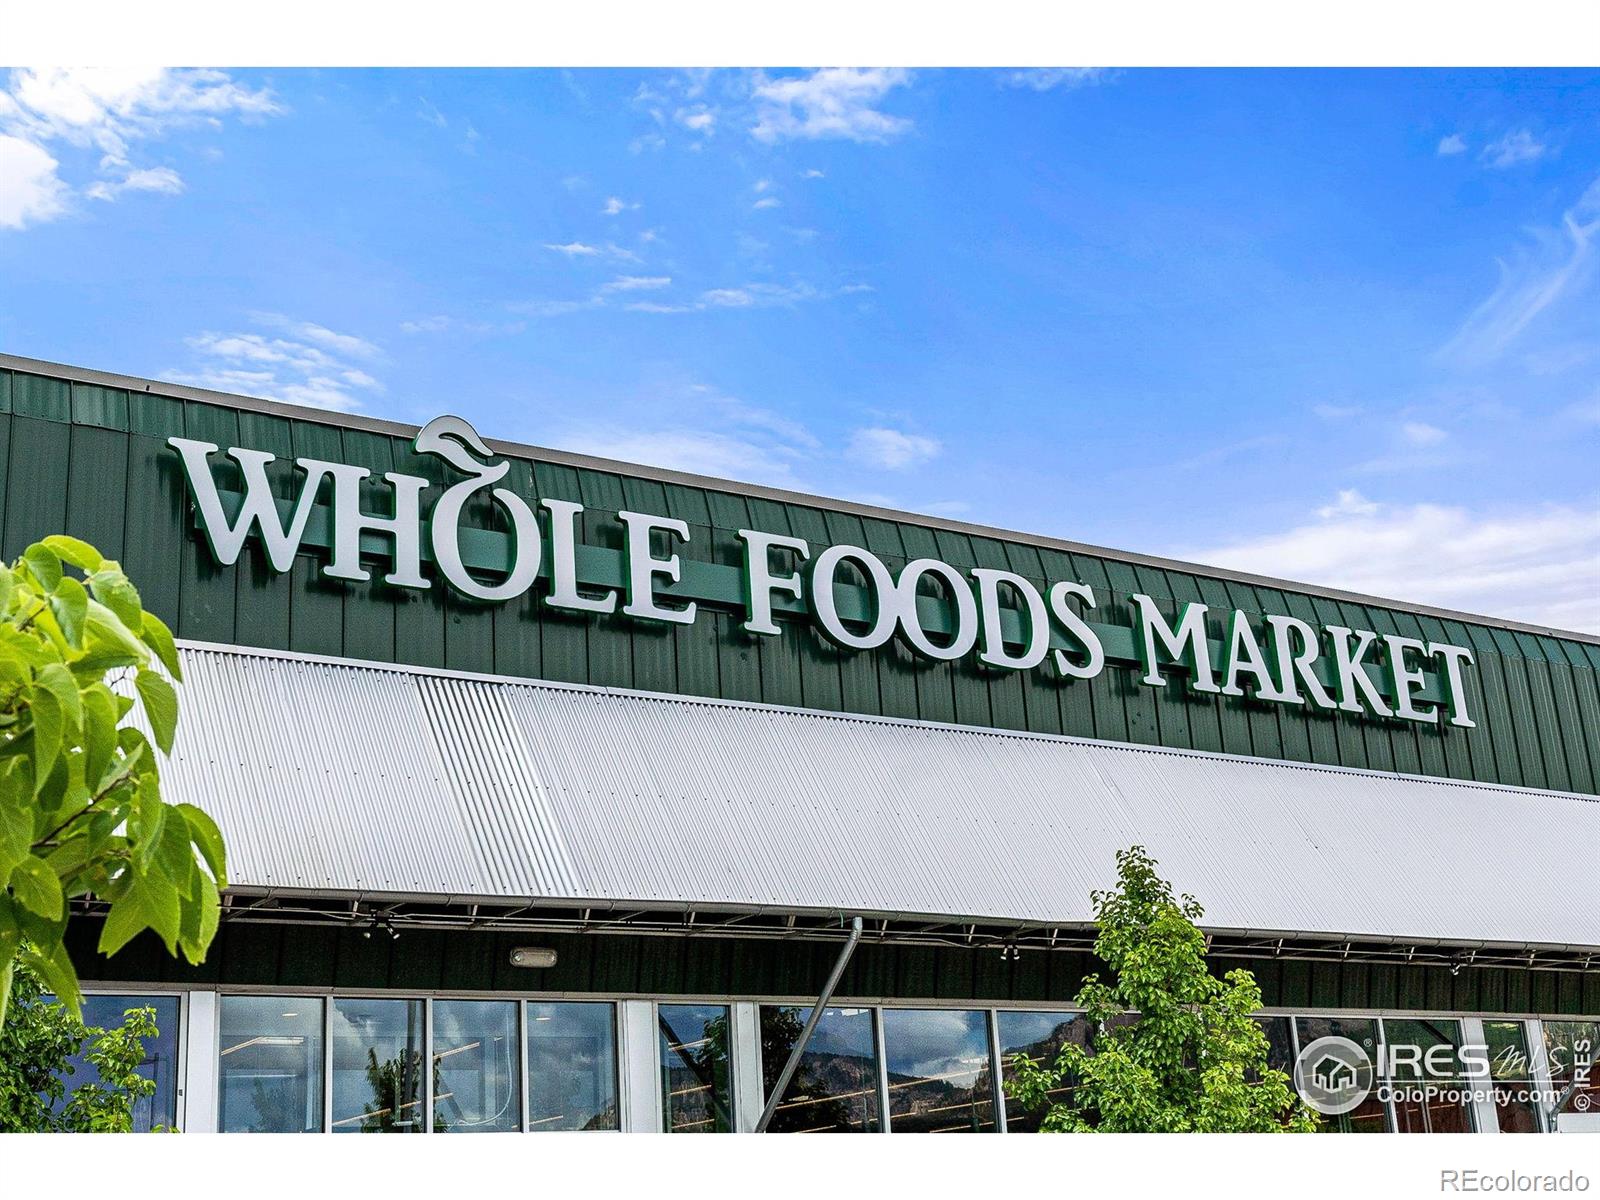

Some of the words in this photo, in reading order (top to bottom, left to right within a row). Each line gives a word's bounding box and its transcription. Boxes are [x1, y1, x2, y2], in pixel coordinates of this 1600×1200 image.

[167, 415, 697, 626] WHOLE
[737, 528, 1106, 680] FOODS
[1131, 593, 1477, 729] MARKET
